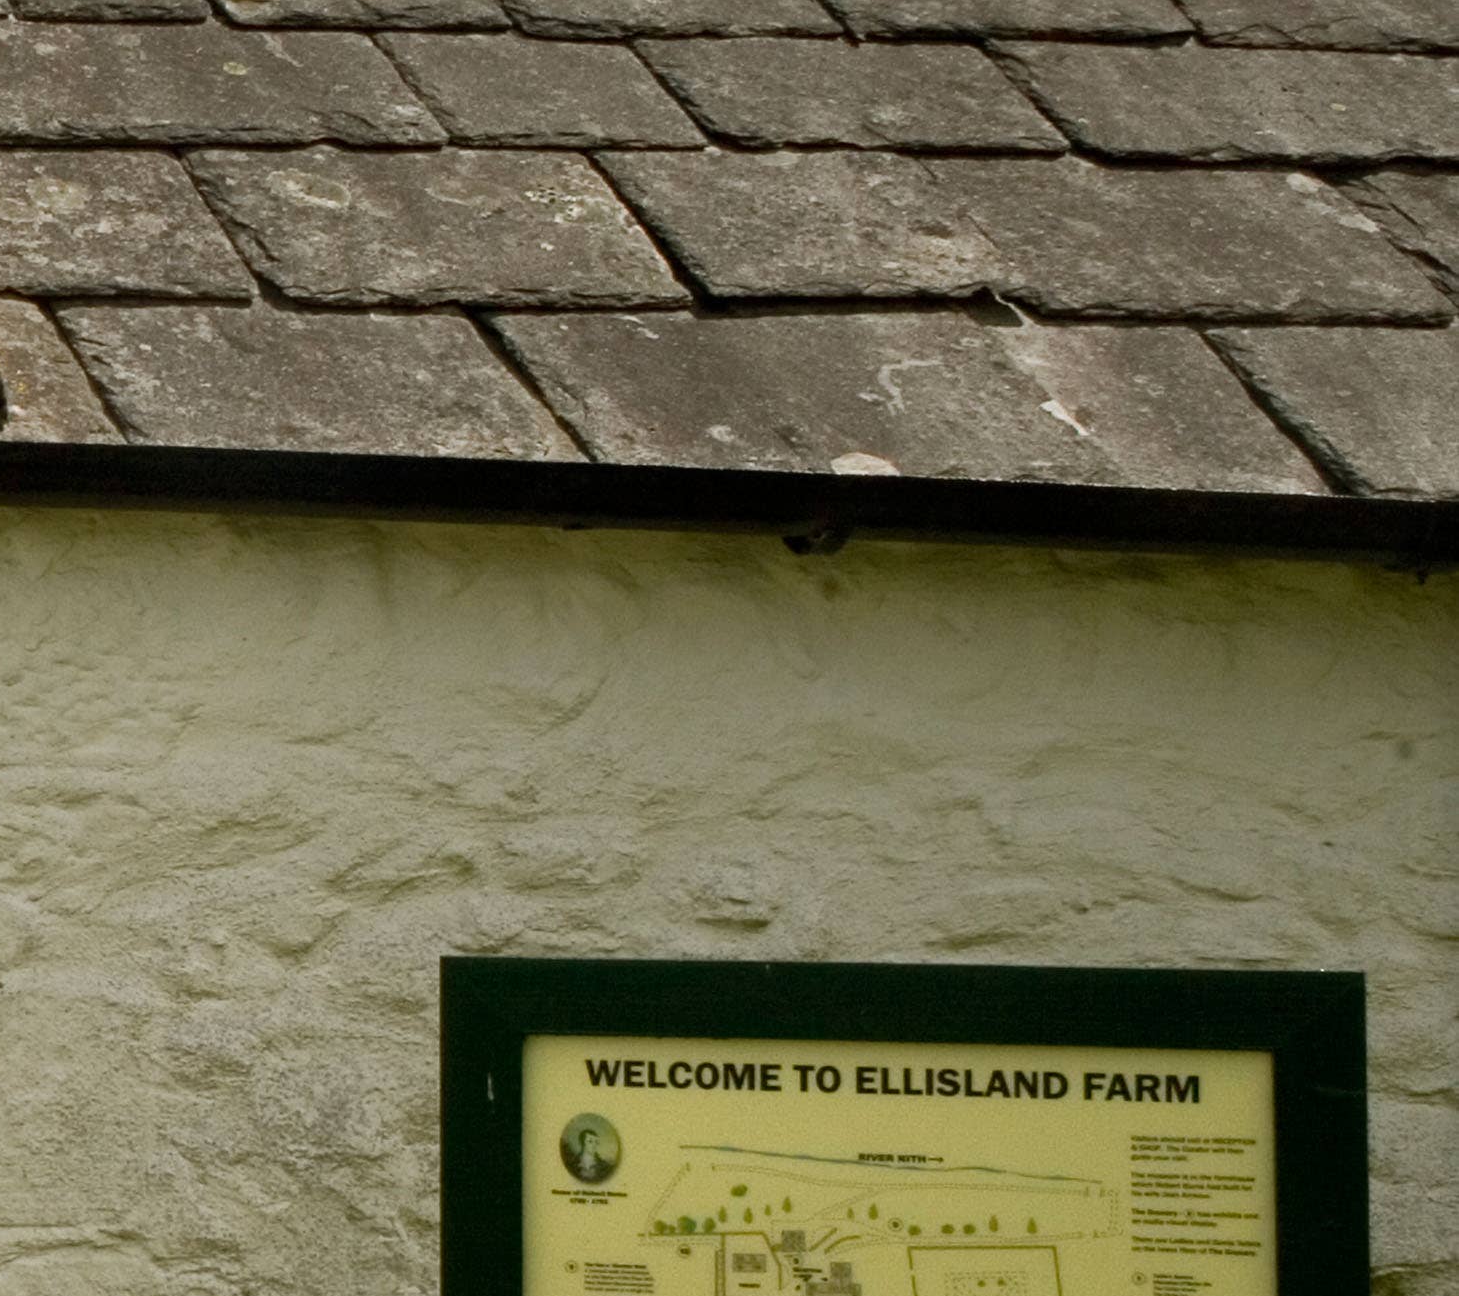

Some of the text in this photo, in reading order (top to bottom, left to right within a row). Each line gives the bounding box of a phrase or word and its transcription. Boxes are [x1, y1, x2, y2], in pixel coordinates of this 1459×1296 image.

[585, 1059, 1200, 1104] WELCOME TO ELLISLAND FARM
[858, 1153, 927, 1163] RIVER NITH
